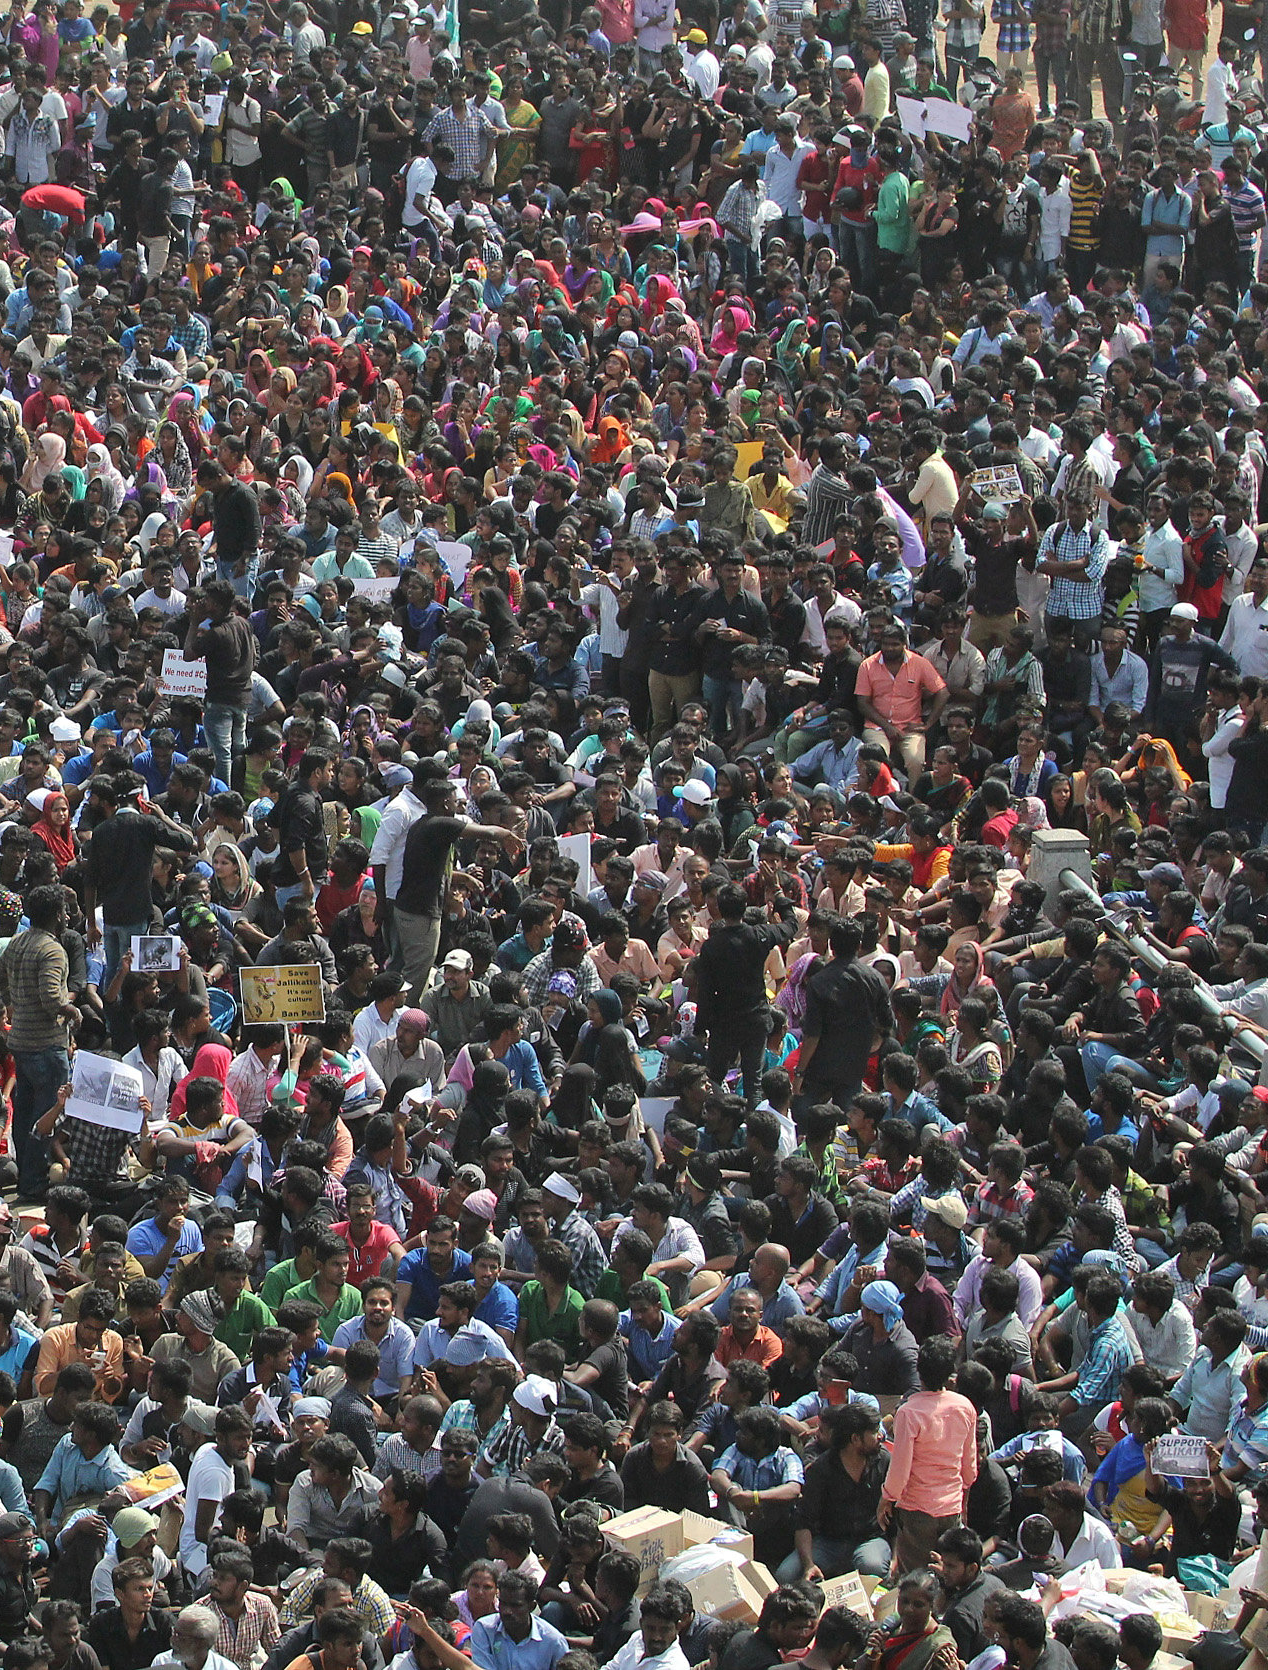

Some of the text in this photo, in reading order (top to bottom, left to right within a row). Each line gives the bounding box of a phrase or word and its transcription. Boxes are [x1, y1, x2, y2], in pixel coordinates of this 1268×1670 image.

[168, 652, 177, 660] We
[164, 667, 175, 676] We
[176, 669, 193, 678] need
[163, 683, 171, 691] We
[173, 685, 187, 693] need
[277, 979, 318, 987] Jallikattu
[281, 1010, 299, 1018] Ban
